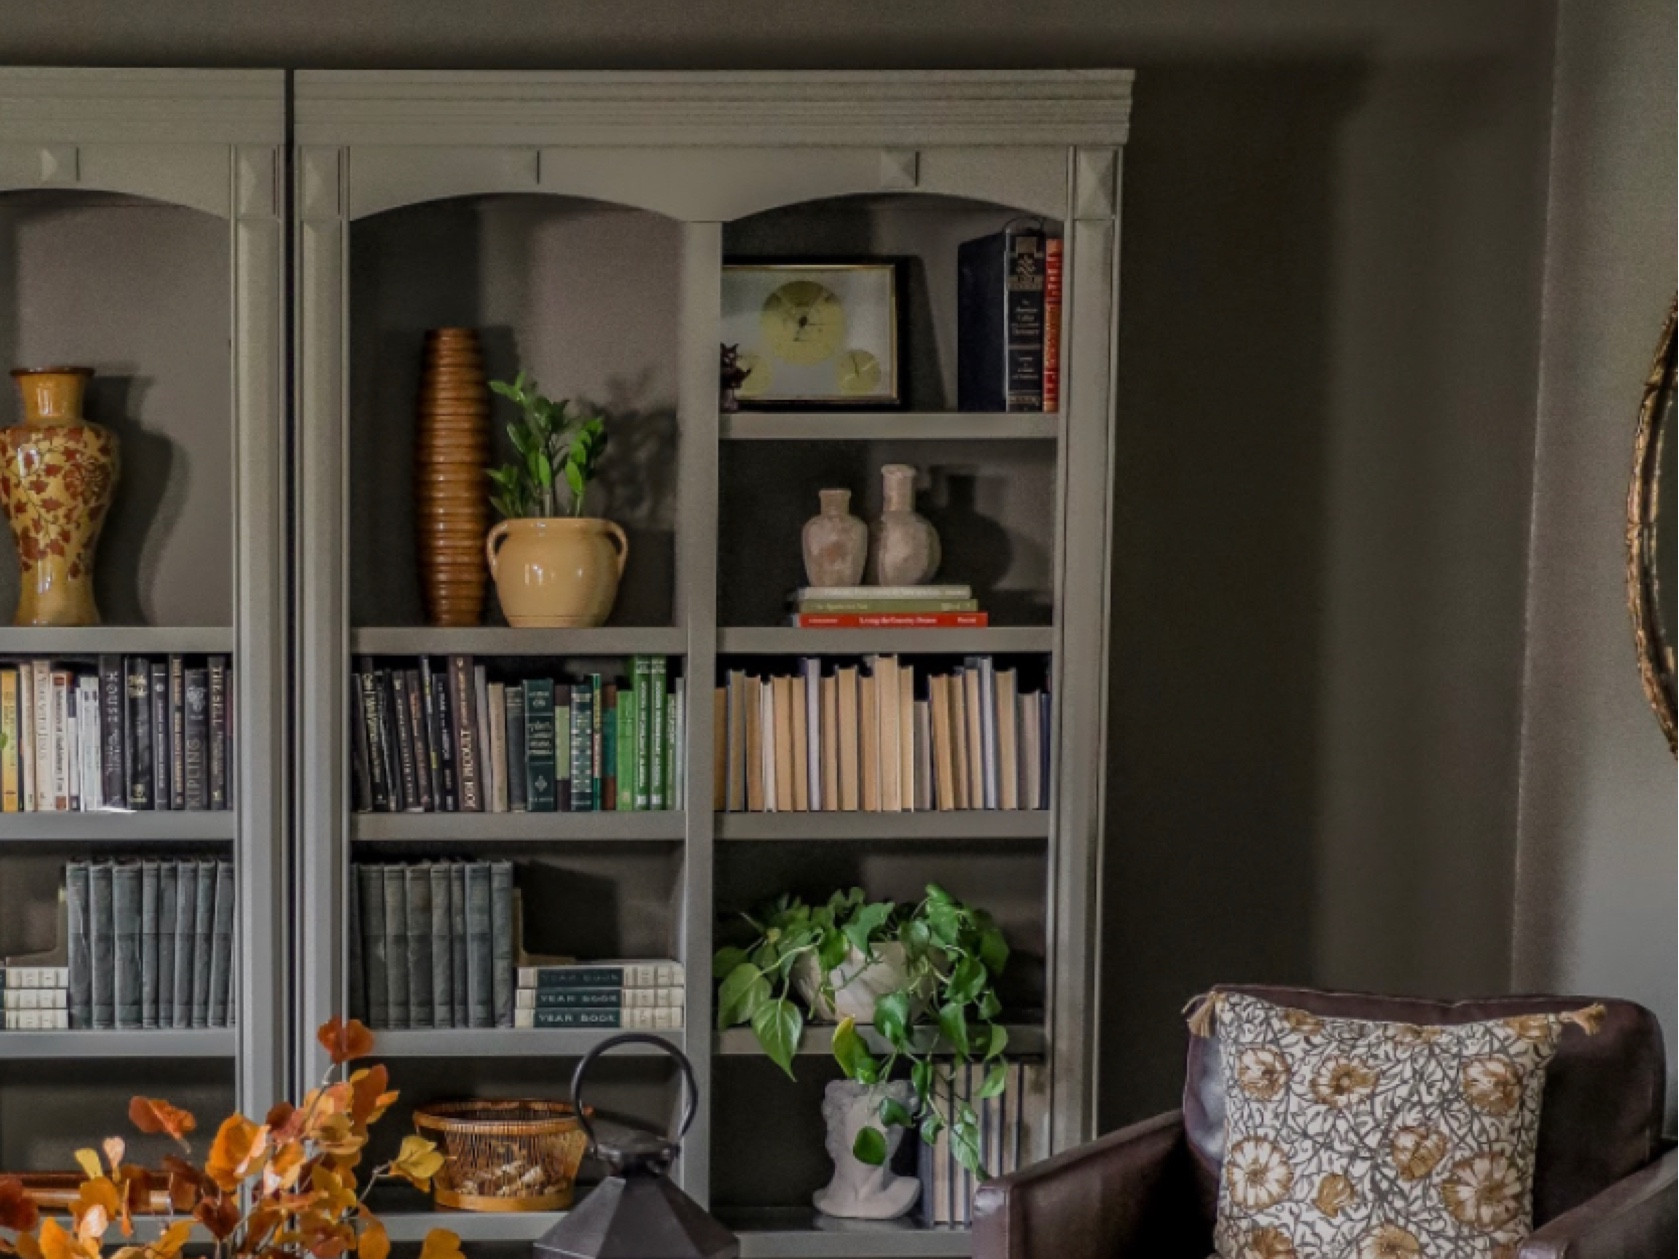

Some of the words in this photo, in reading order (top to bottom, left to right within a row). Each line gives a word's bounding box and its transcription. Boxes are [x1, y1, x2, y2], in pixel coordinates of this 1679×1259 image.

[186, 739, 201, 807] KIPLING
[540, 994, 577, 1003] YEAR
[582, 994, 618, 1003] BOOK
[538, 1013, 573, 1022] YEAR
[580, 1013, 616, 1022] BOOK
